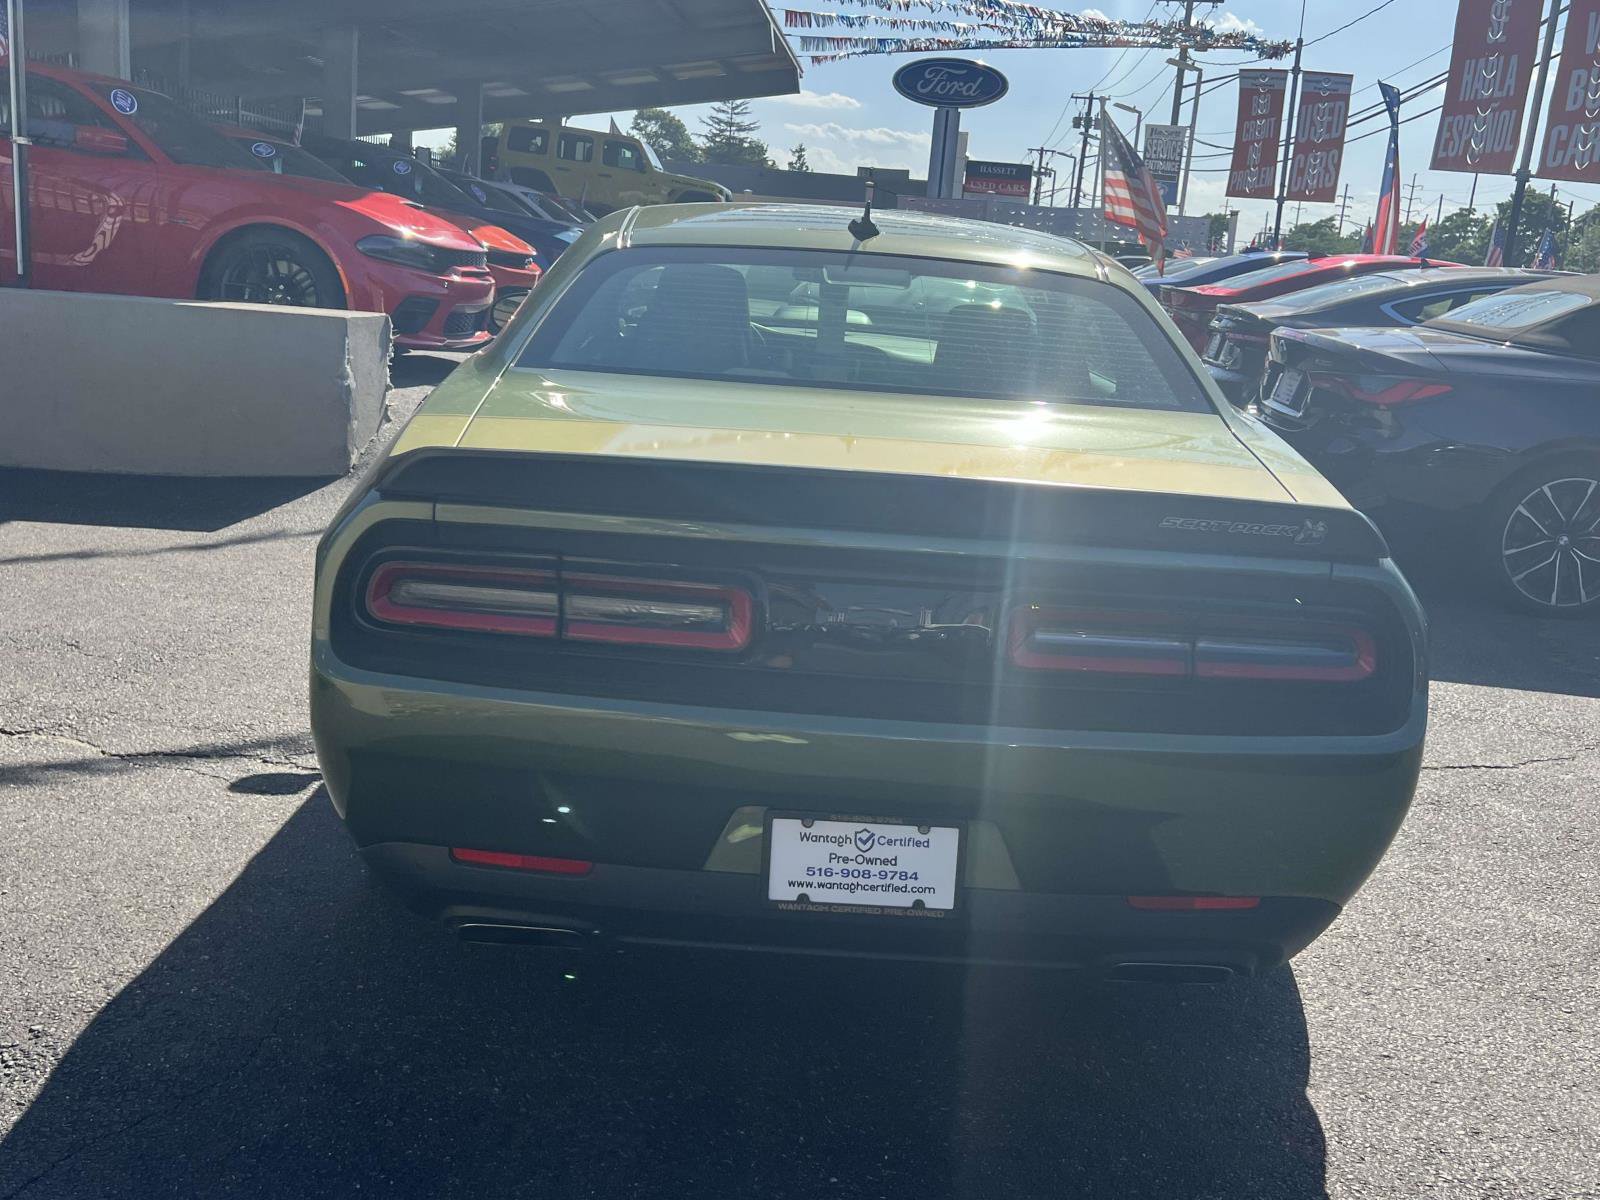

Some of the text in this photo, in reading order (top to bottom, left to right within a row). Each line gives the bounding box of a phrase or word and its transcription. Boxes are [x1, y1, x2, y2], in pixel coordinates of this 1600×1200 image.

[917, 66, 983, 96] Ford
[1459, 55, 1518, 102] HABLA
[1242, 117, 1277, 142] CREDIT
[1297, 101, 1345, 143] USED
[1437, 102, 1518, 159] ESPAÑOL
[1146, 139, 1183, 161] SERVICE
[979, 164, 1018, 175] HASSETT
[1229, 166, 1275, 192] PROBLEM
[1290, 149, 1338, 192] CARS
[969, 180, 1025, 193] USED CARS
[1228, 521, 1299, 537] PACK
[799, 832, 930, 849] Wantagh Certified
[828, 852, 898, 867] Pre-Owned
[806, 866, 919, 881] 516-908-9784
[787, 879, 936, 895] www.wantaghcertified.com
[777, 903, 945, 918] WANTAGH CERTIFIED PRE-OWNED
